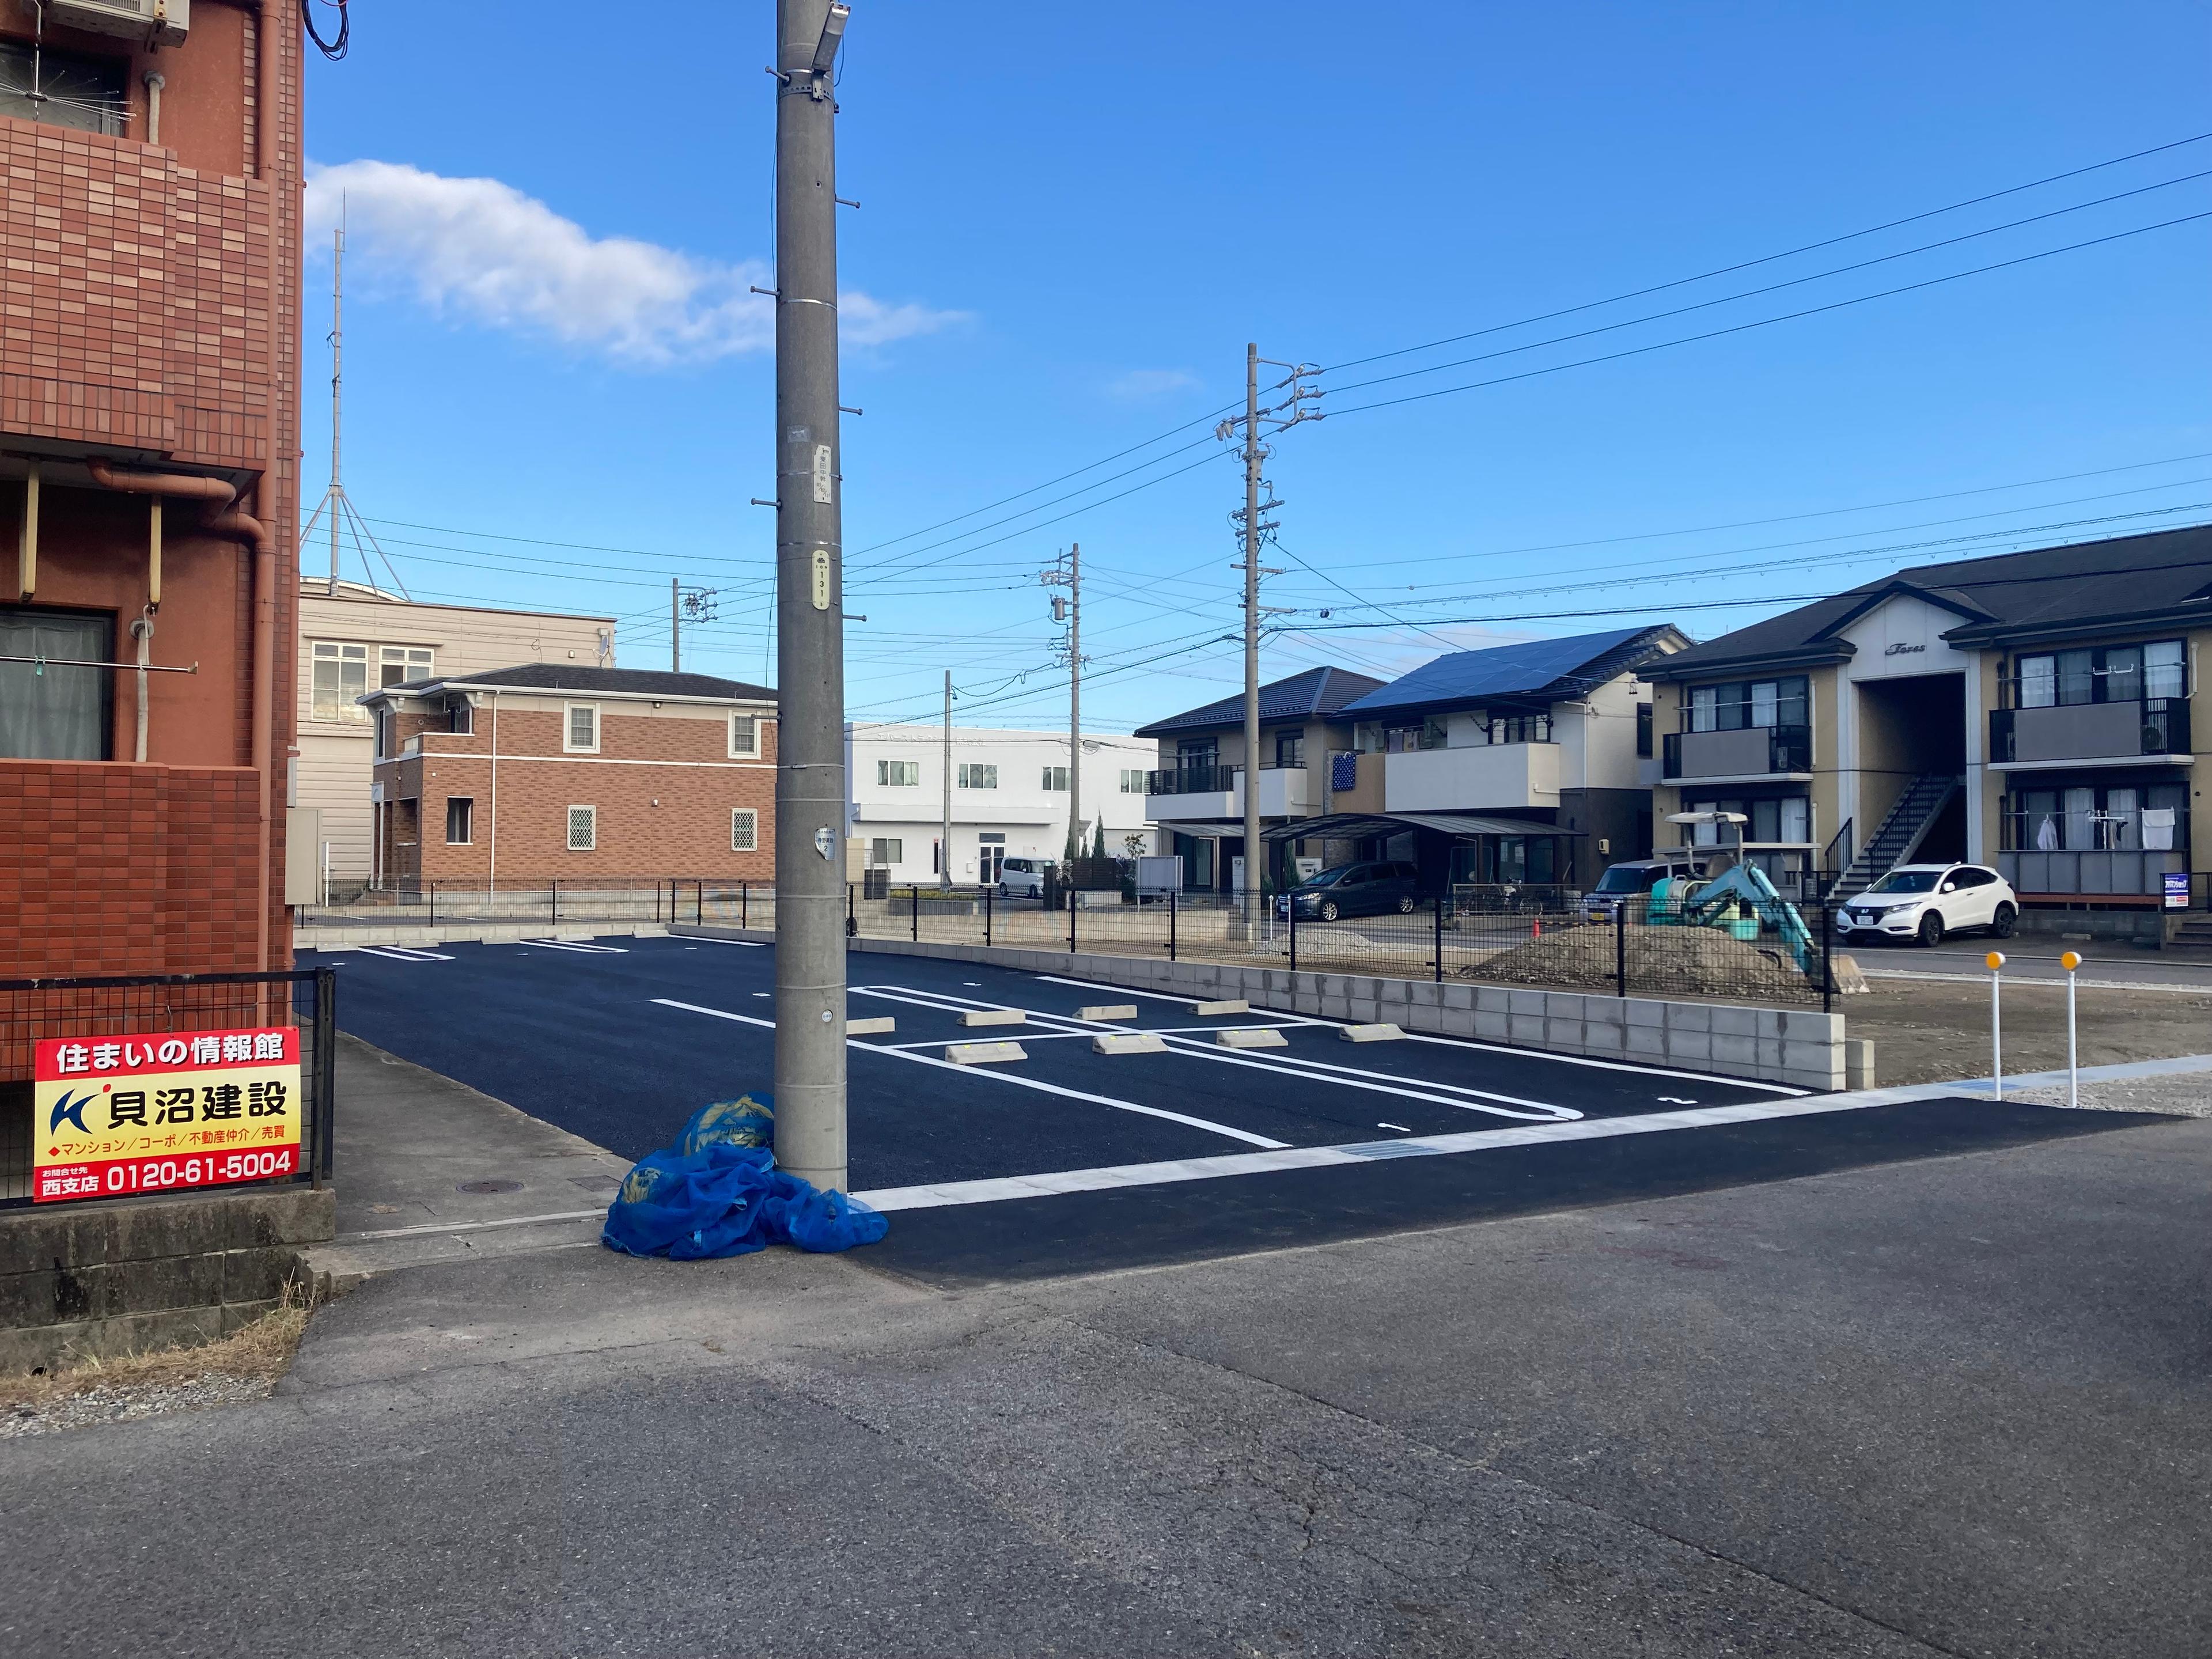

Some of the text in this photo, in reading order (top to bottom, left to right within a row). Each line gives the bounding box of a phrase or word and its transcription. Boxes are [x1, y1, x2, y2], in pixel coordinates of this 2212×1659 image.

[56, 1032, 284, 1074] 住まいの情報館
[108, 1081, 287, 1130] 貝沼建設
[42, 1166, 88, 1177] お問合せ先
[42, 1150, 291, 1196] 西支店 0120-61-5004
